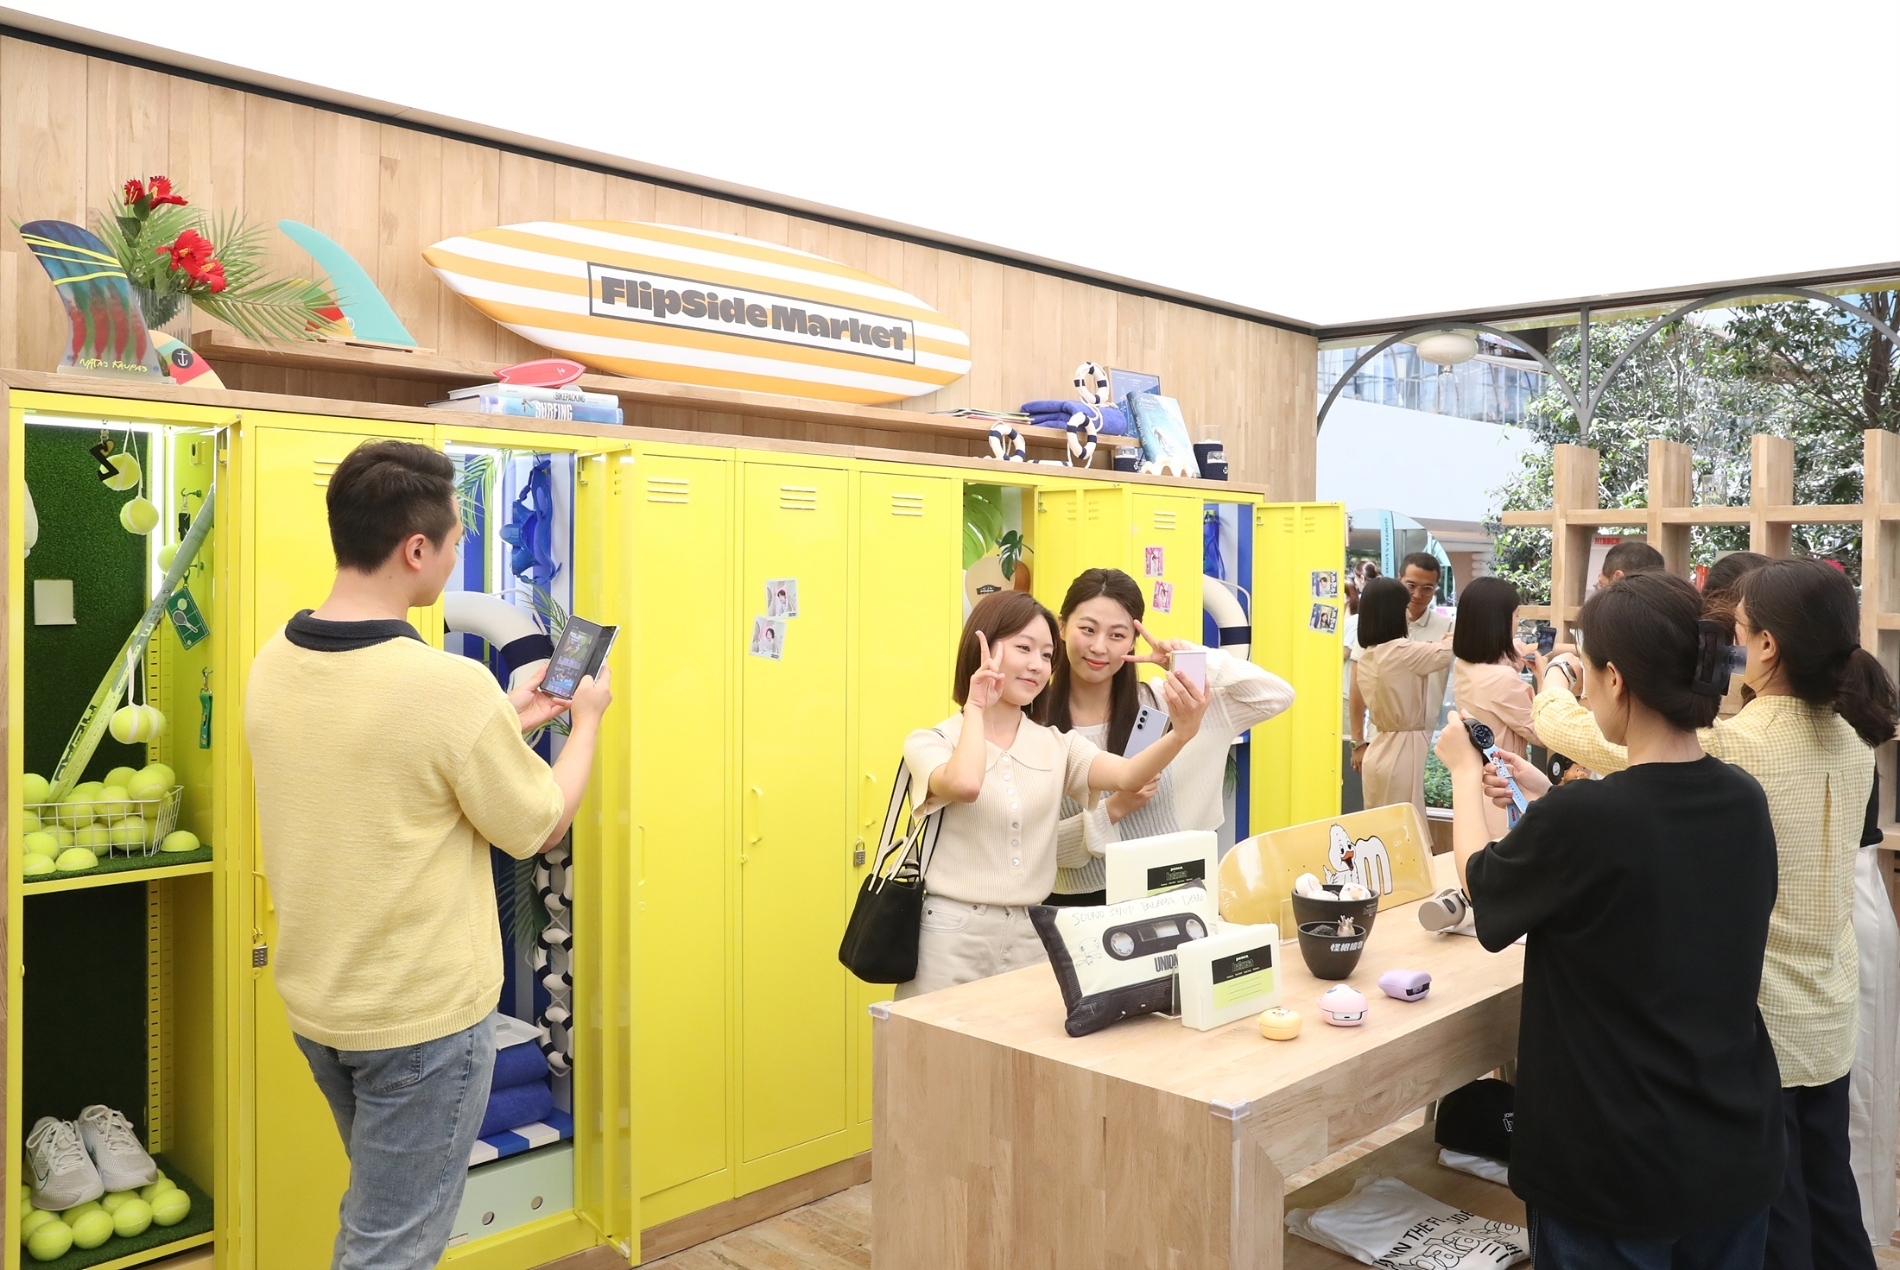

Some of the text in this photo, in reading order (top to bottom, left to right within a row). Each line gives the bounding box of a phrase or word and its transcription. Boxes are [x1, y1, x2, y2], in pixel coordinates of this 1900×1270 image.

[771, 304, 907, 351] Market
[535, 400, 573, 421] SURFING
[1403, 1219, 1434, 1241] THE
